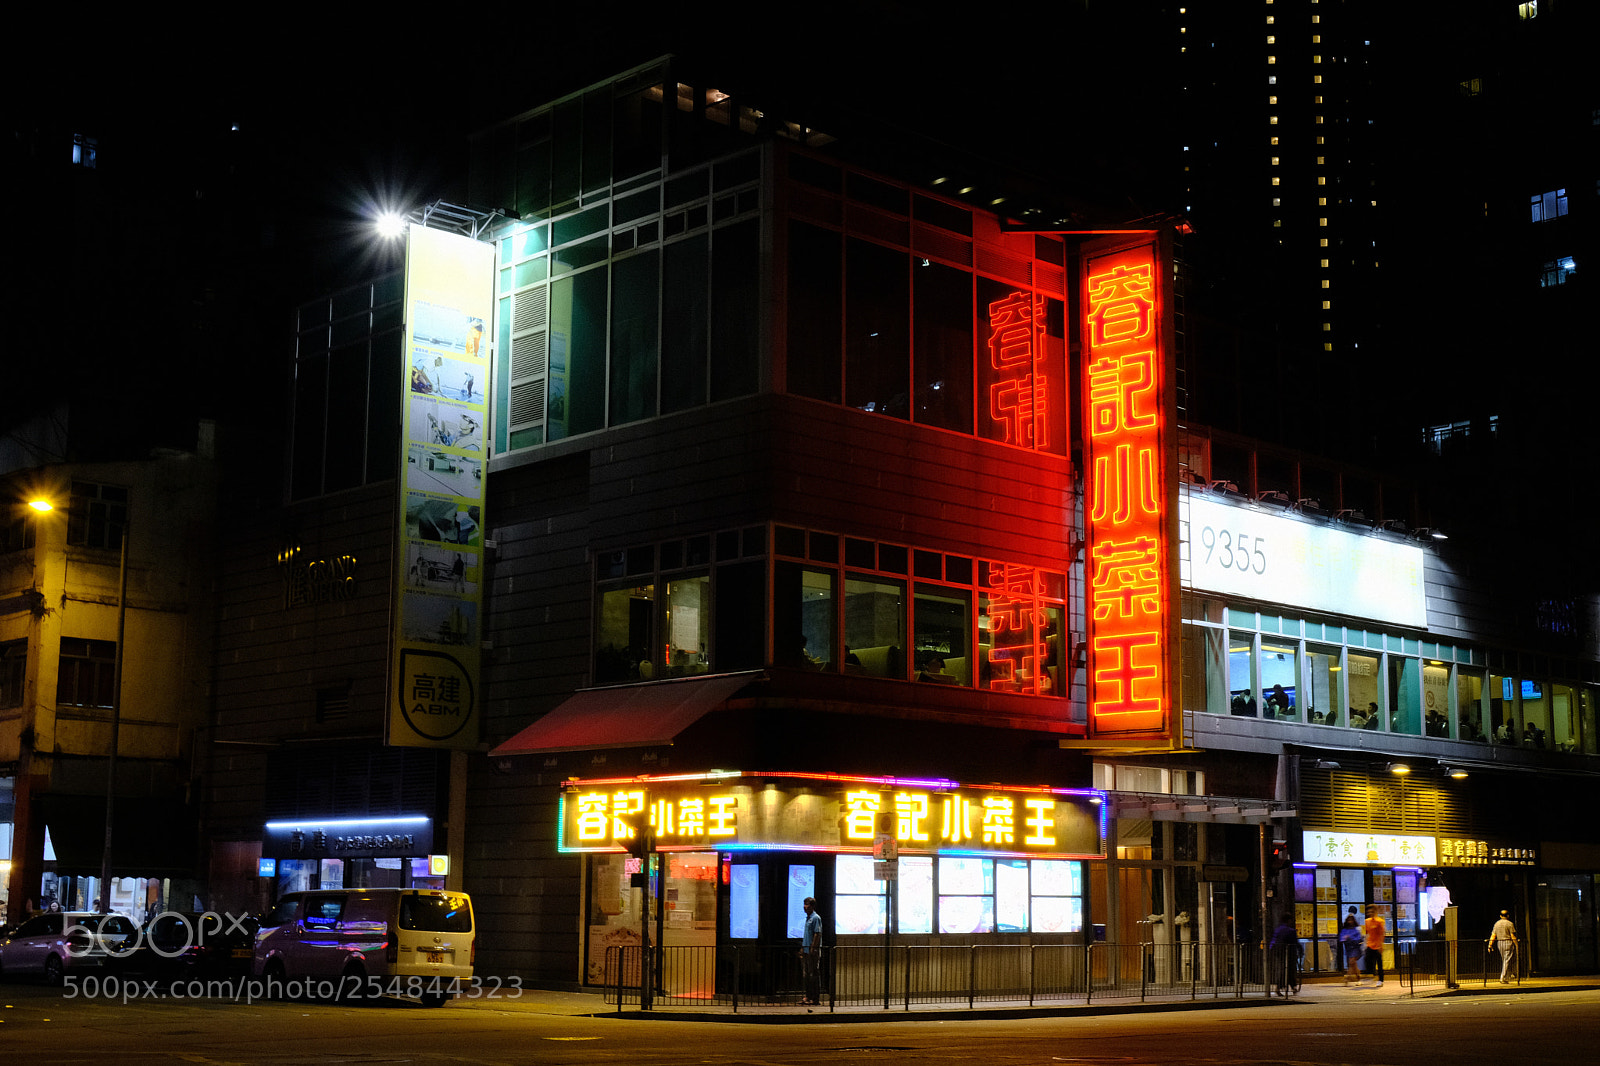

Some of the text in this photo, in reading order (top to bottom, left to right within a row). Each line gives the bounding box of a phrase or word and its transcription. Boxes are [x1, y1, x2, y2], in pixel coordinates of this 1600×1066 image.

[1087, 262, 1163, 718] 容記小菜王
[1201, 526, 1267, 576] 9355
[411, 673, 461, 705] 高建
[411, 703, 461, 718] ABM
[577, 790, 738, 841] 容記小菜王
[845, 790, 1057, 846] 容記小菜王
